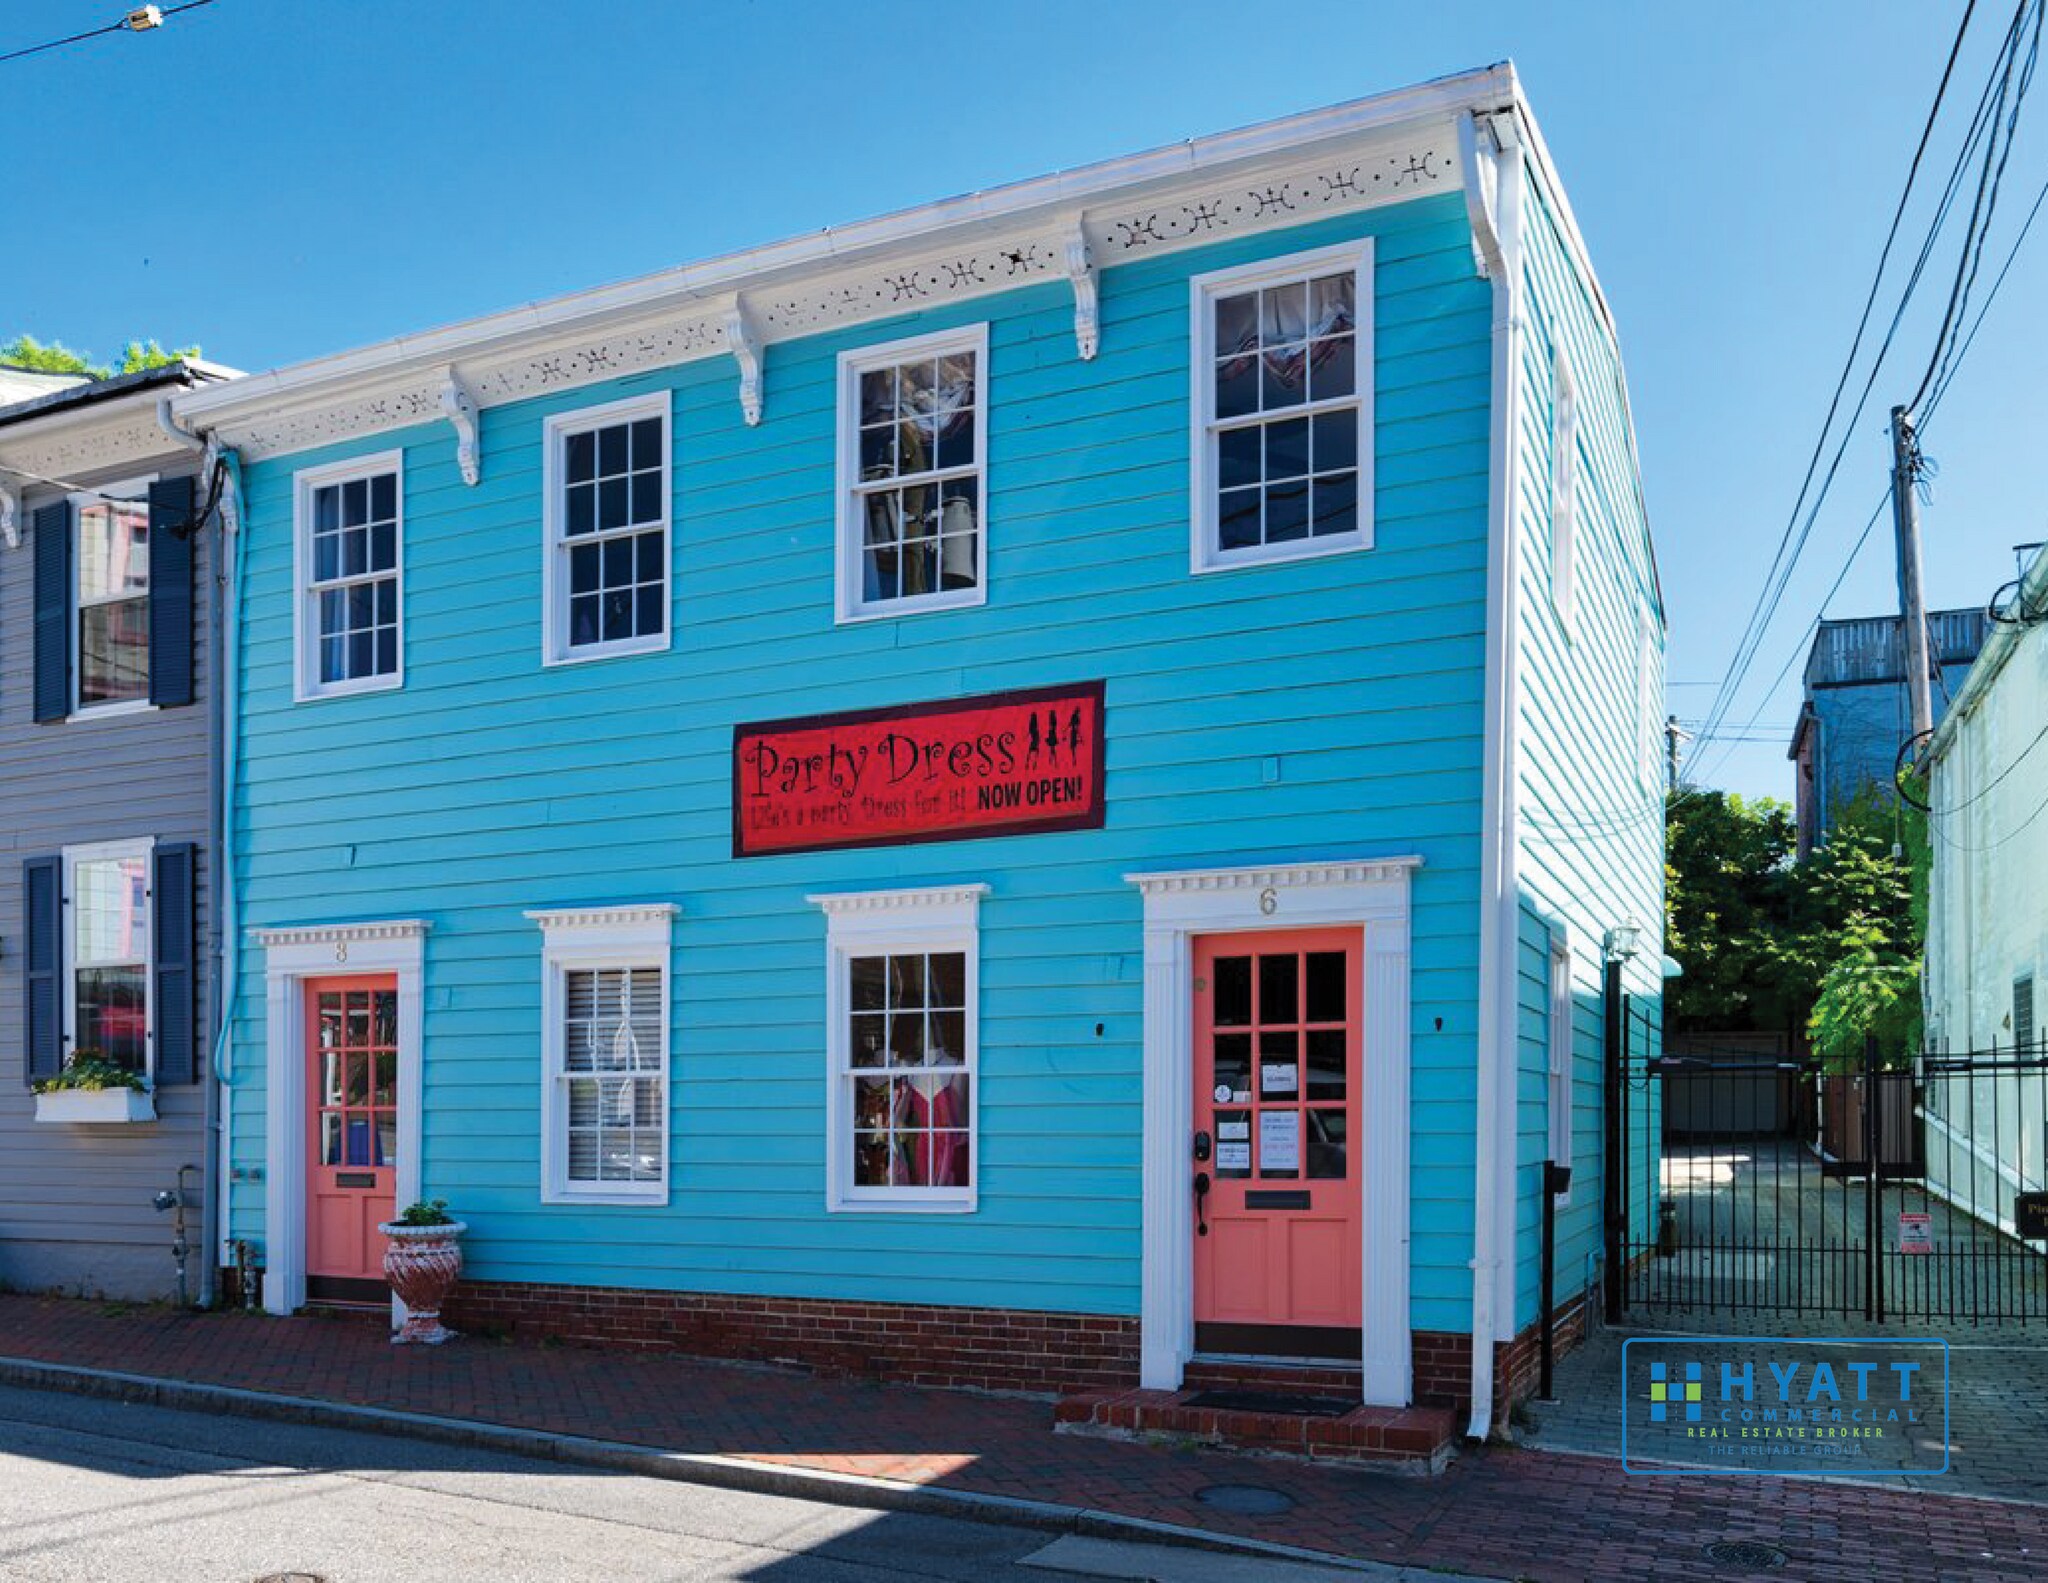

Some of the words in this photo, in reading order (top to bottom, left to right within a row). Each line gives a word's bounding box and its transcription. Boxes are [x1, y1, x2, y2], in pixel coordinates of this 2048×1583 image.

[745, 740, 868, 798] Party
[877, 731, 1016, 784] Dress
[979, 782, 1021, 810] NOW
[1026, 775, 1083, 805] OPEN!
[1260, 888, 1277, 915] 6
